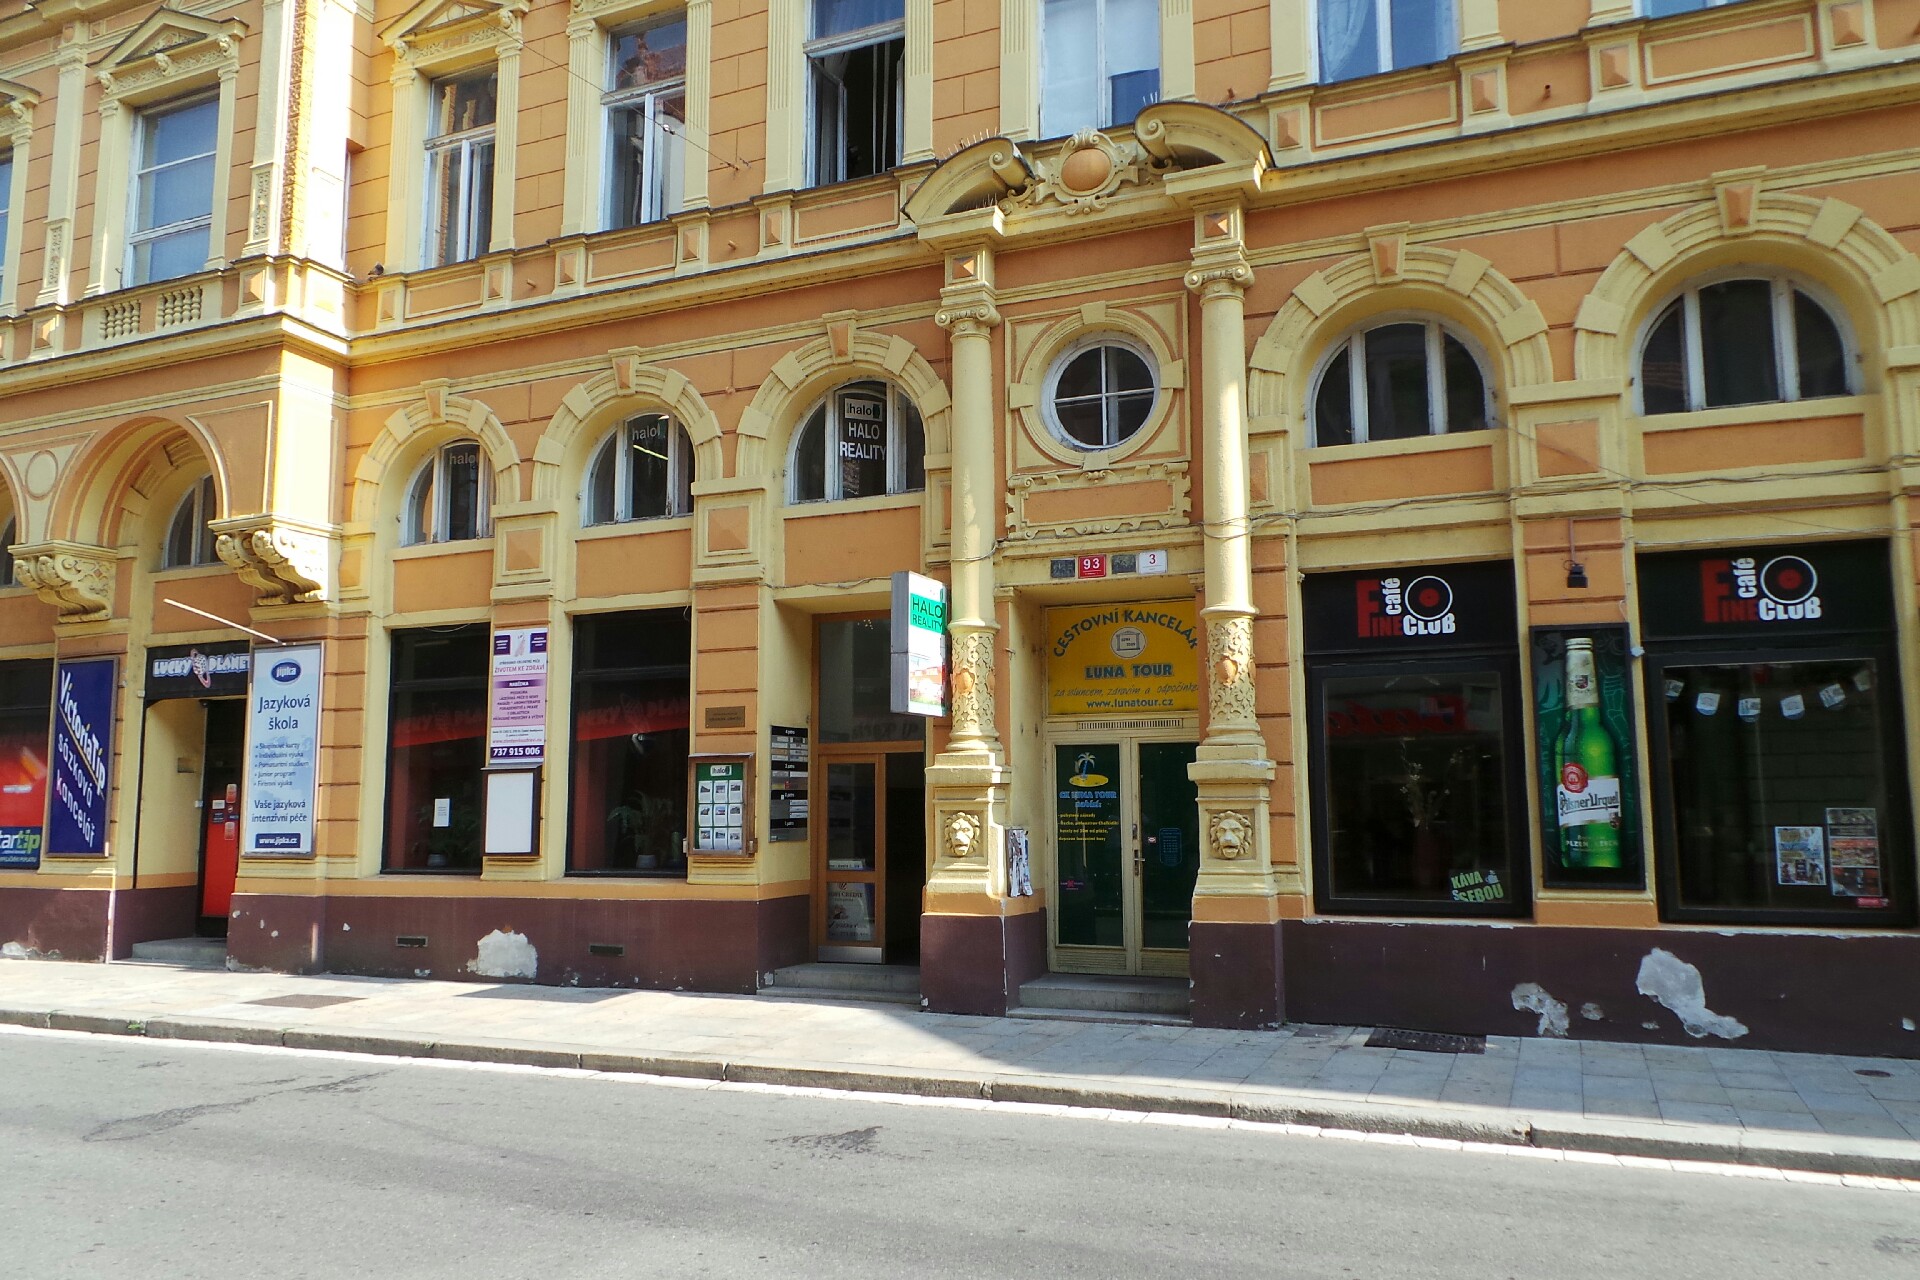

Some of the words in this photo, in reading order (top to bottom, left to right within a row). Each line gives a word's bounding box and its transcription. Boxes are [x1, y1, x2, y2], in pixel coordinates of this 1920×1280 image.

[849, 403, 872, 416] halo
[848, 422, 880, 440] HALO
[840, 441, 887, 460] REALITY
[1084, 558, 1100, 570] 93
[1149, 554, 1156, 565] 3
[1732, 557, 1758, 598] café
[1381, 577, 1402, 615] café
[912, 597, 943, 619] HALO
[1357, 580, 1403, 637] FINE
[1403, 613, 1456, 636] CLUB
[1759, 596, 1822, 621] CLUB
[912, 614, 943, 630] REALITY
[1053, 607, 1119, 657] CESTOVNÍ
[153, 658, 192, 676] LUCKY
[1085, 666, 1125, 680] LUNA
[1132, 664, 1173, 677] TOUR
[257, 693, 312, 714] Jazyková
[1087, 698, 1174, 708] www.lunatour.cz
[268, 716, 298, 730] škola
[493, 748, 508, 757] 737
[509, 748, 524, 756] 915
[525, 747, 540, 756] 006
[254, 799, 272, 809] Vaše
[273, 798, 306, 811] jazyková
[289, 812, 307, 824] péče
[1451, 871, 1484, 889] KÁVA
[1458, 883, 1504, 902] SEBOU
